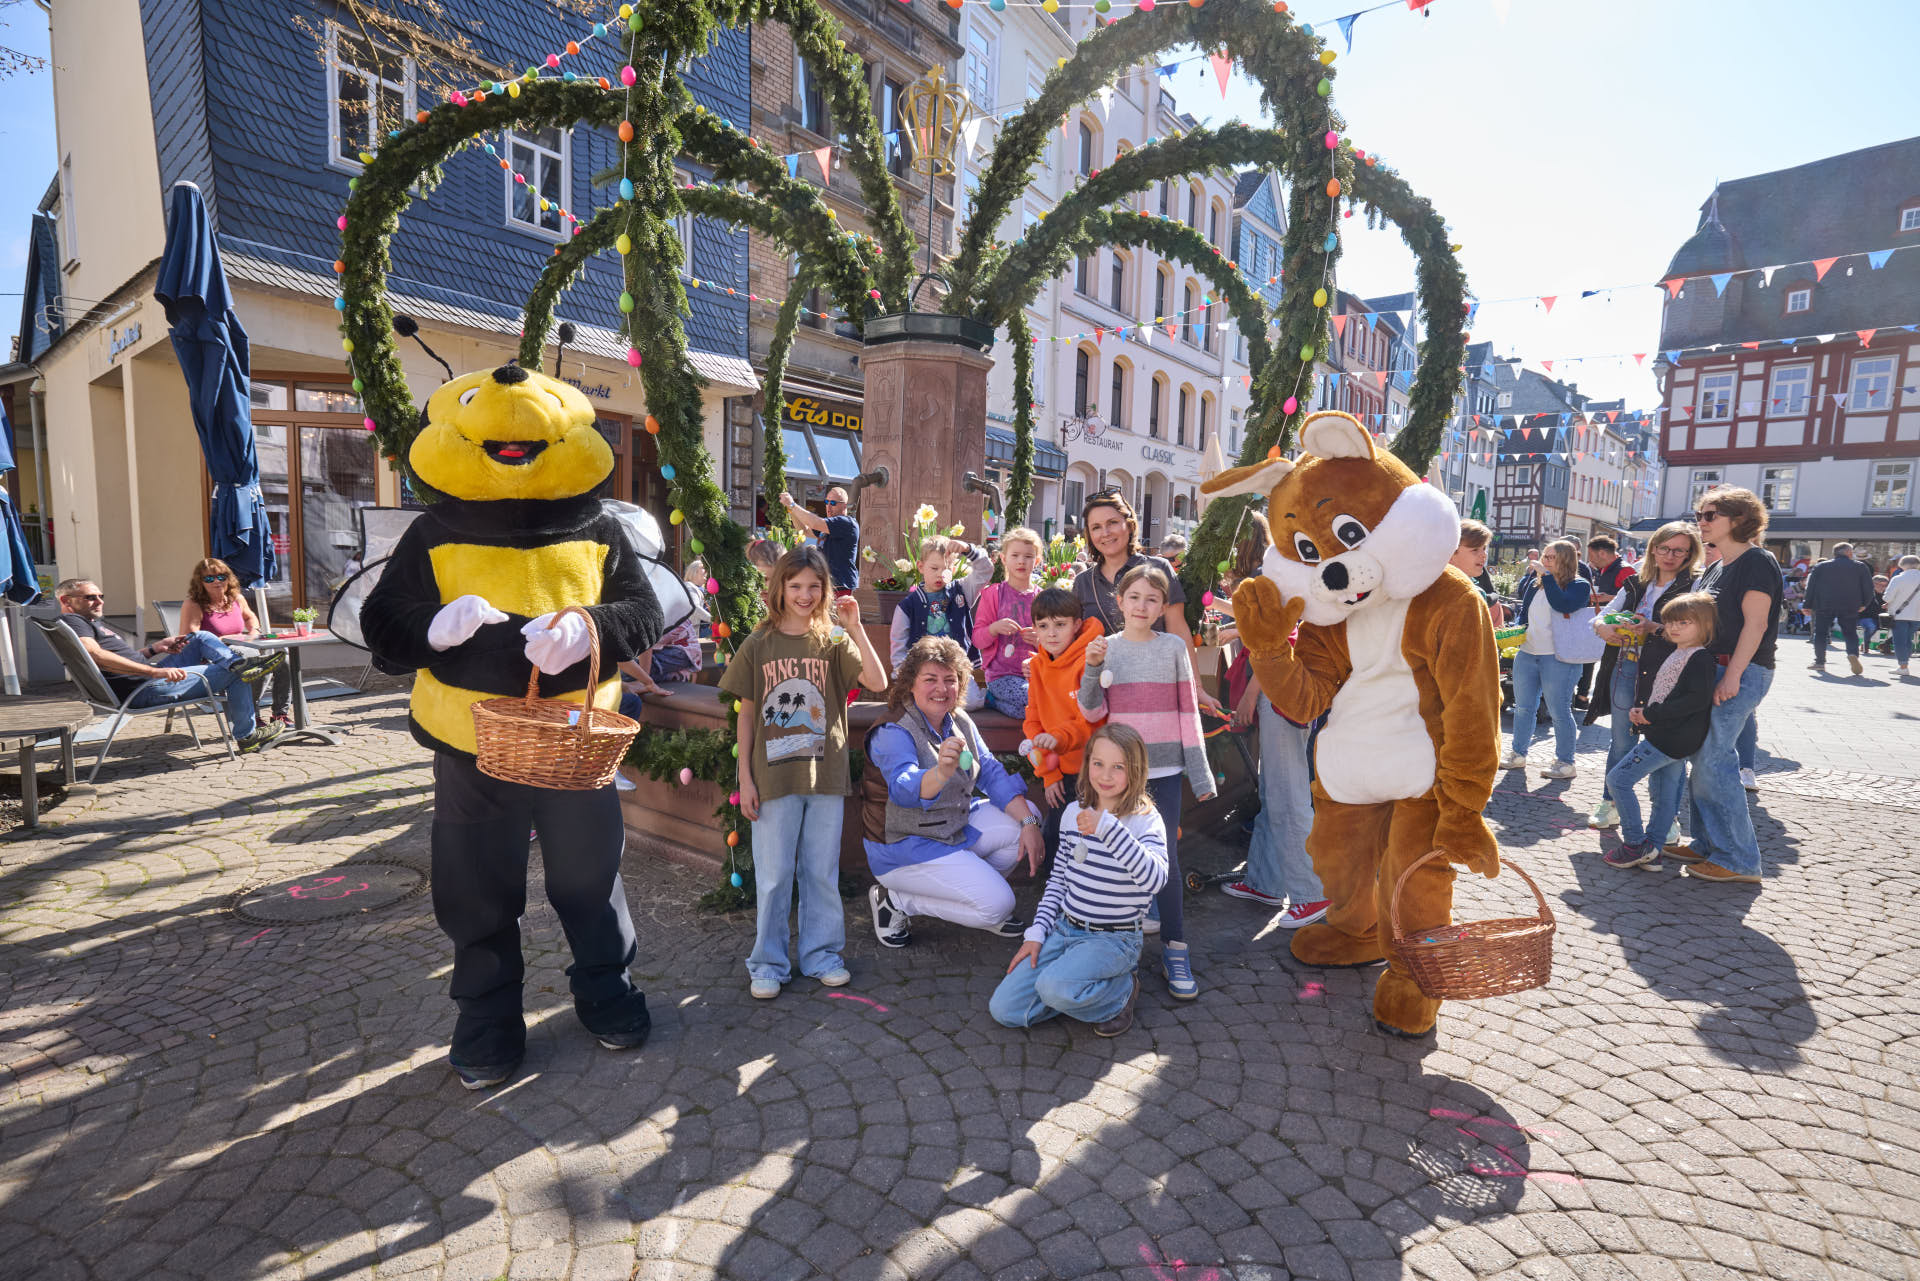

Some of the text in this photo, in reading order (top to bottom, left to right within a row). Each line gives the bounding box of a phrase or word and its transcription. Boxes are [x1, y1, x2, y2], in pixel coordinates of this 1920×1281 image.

[785, 397, 864, 431] Eis DO
[1083, 434, 1124, 452] RESTAURANT
[1141, 445, 1176, 466] CLASSIC
[801, 658, 829, 696] TEN
